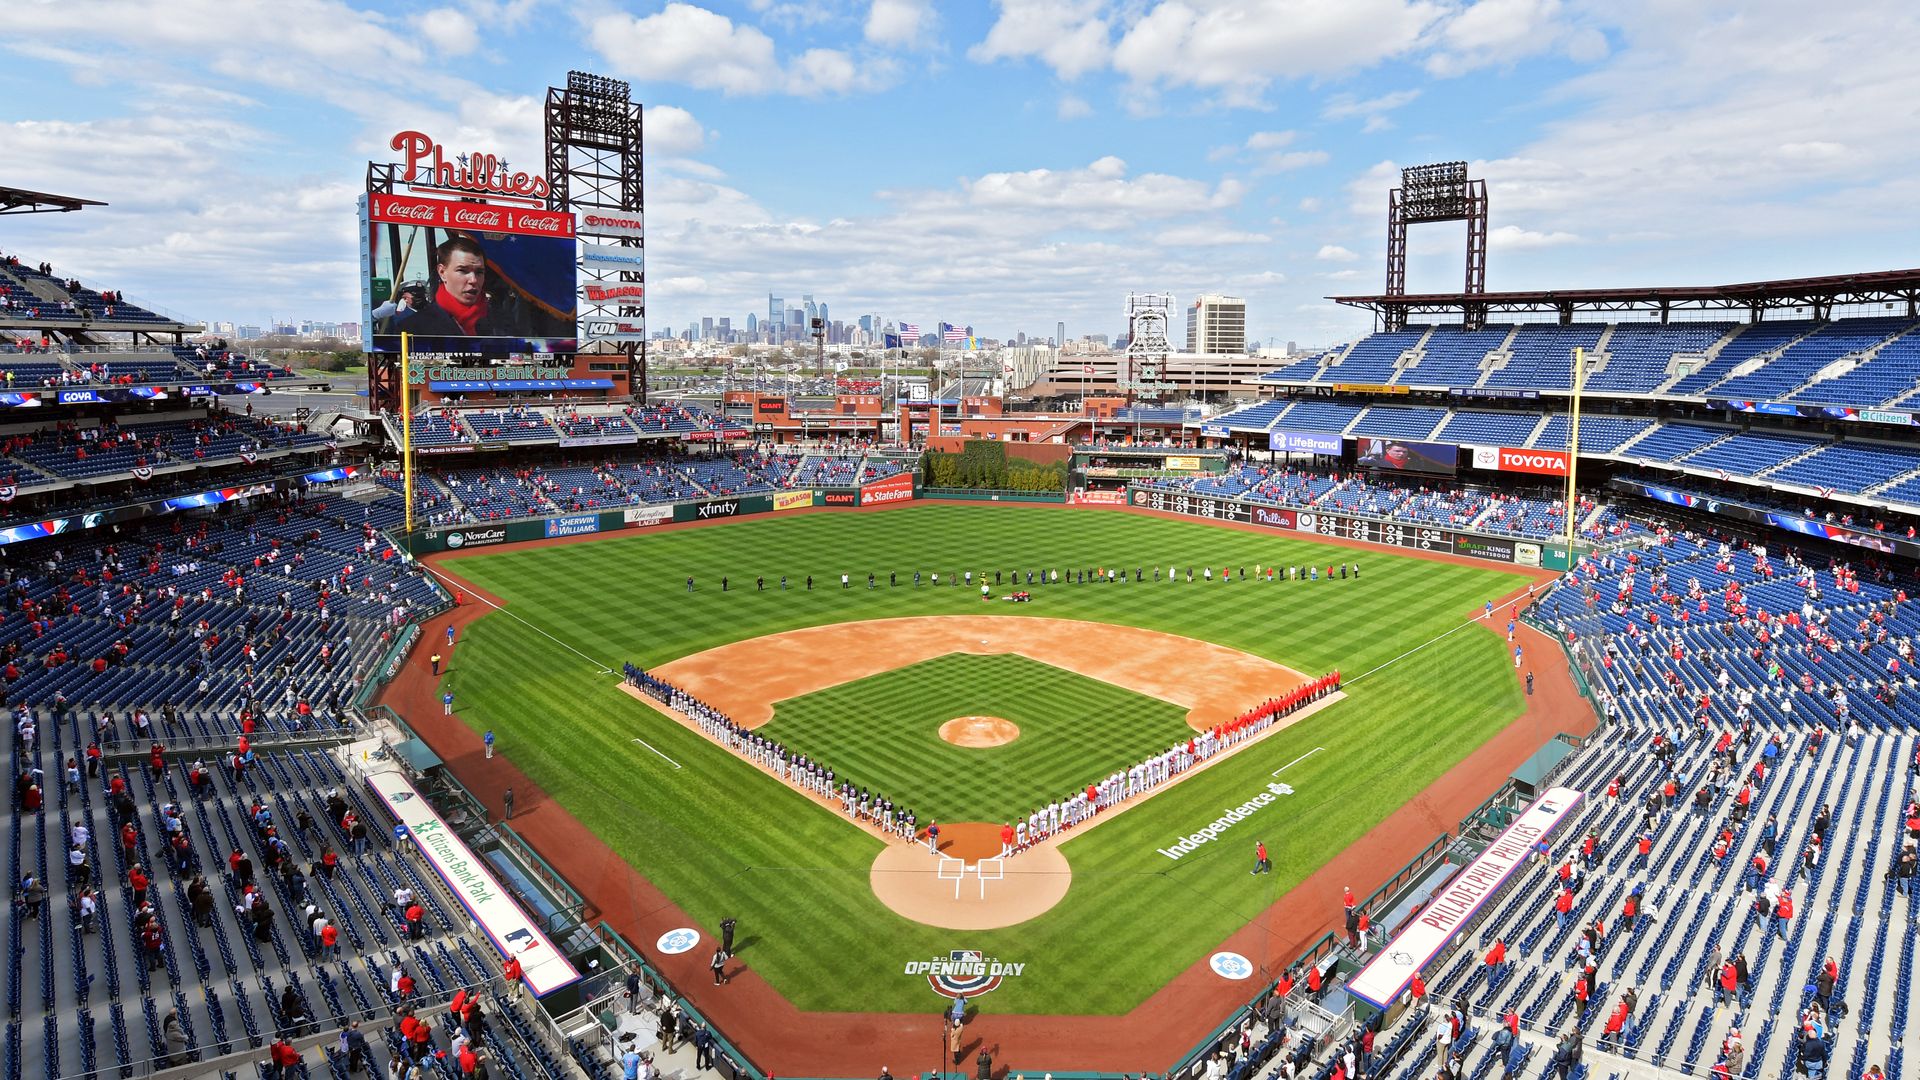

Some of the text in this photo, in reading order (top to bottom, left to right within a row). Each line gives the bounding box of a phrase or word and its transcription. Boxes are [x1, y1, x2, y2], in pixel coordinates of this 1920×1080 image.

[390, 130, 550, 198] Phillies
[386, 202, 437, 220] Coca-Cola
[455, 208, 502, 226] Coca-Cola
[518, 214, 561, 232] Coca-Cola
[599, 217, 642, 229] TOYOTA
[588, 322, 617, 335] KDI
[429, 365, 569, 381] Citizens Bank Park
[64, 392, 92, 403] GOYA
[1870, 413, 1908, 423] Citizens
[1289, 437, 1338, 449] LifeBrand
[1502, 453, 1566, 470] TOYOTA
[825, 494, 854, 502] GIANT
[698, 501, 738, 518] xfinity
[560, 517, 595, 526] SHERWIN
[1257, 509, 1290, 526] Phillies
[464, 530, 506, 541] NovaCare
[464, 538, 504, 546] REHABILITATION
[1458, 542, 1511, 554] DRAFTKINGS
[1470, 549, 1510, 559] SPORTSBOOK
[1156, 793, 1276, 860] Independence
[426, 832, 495, 904] Citizens Bank Park
[1421, 823, 1542, 932] PHILADELPHIA PHILLIES
[904, 961, 1026, 976] OPENING DAY
